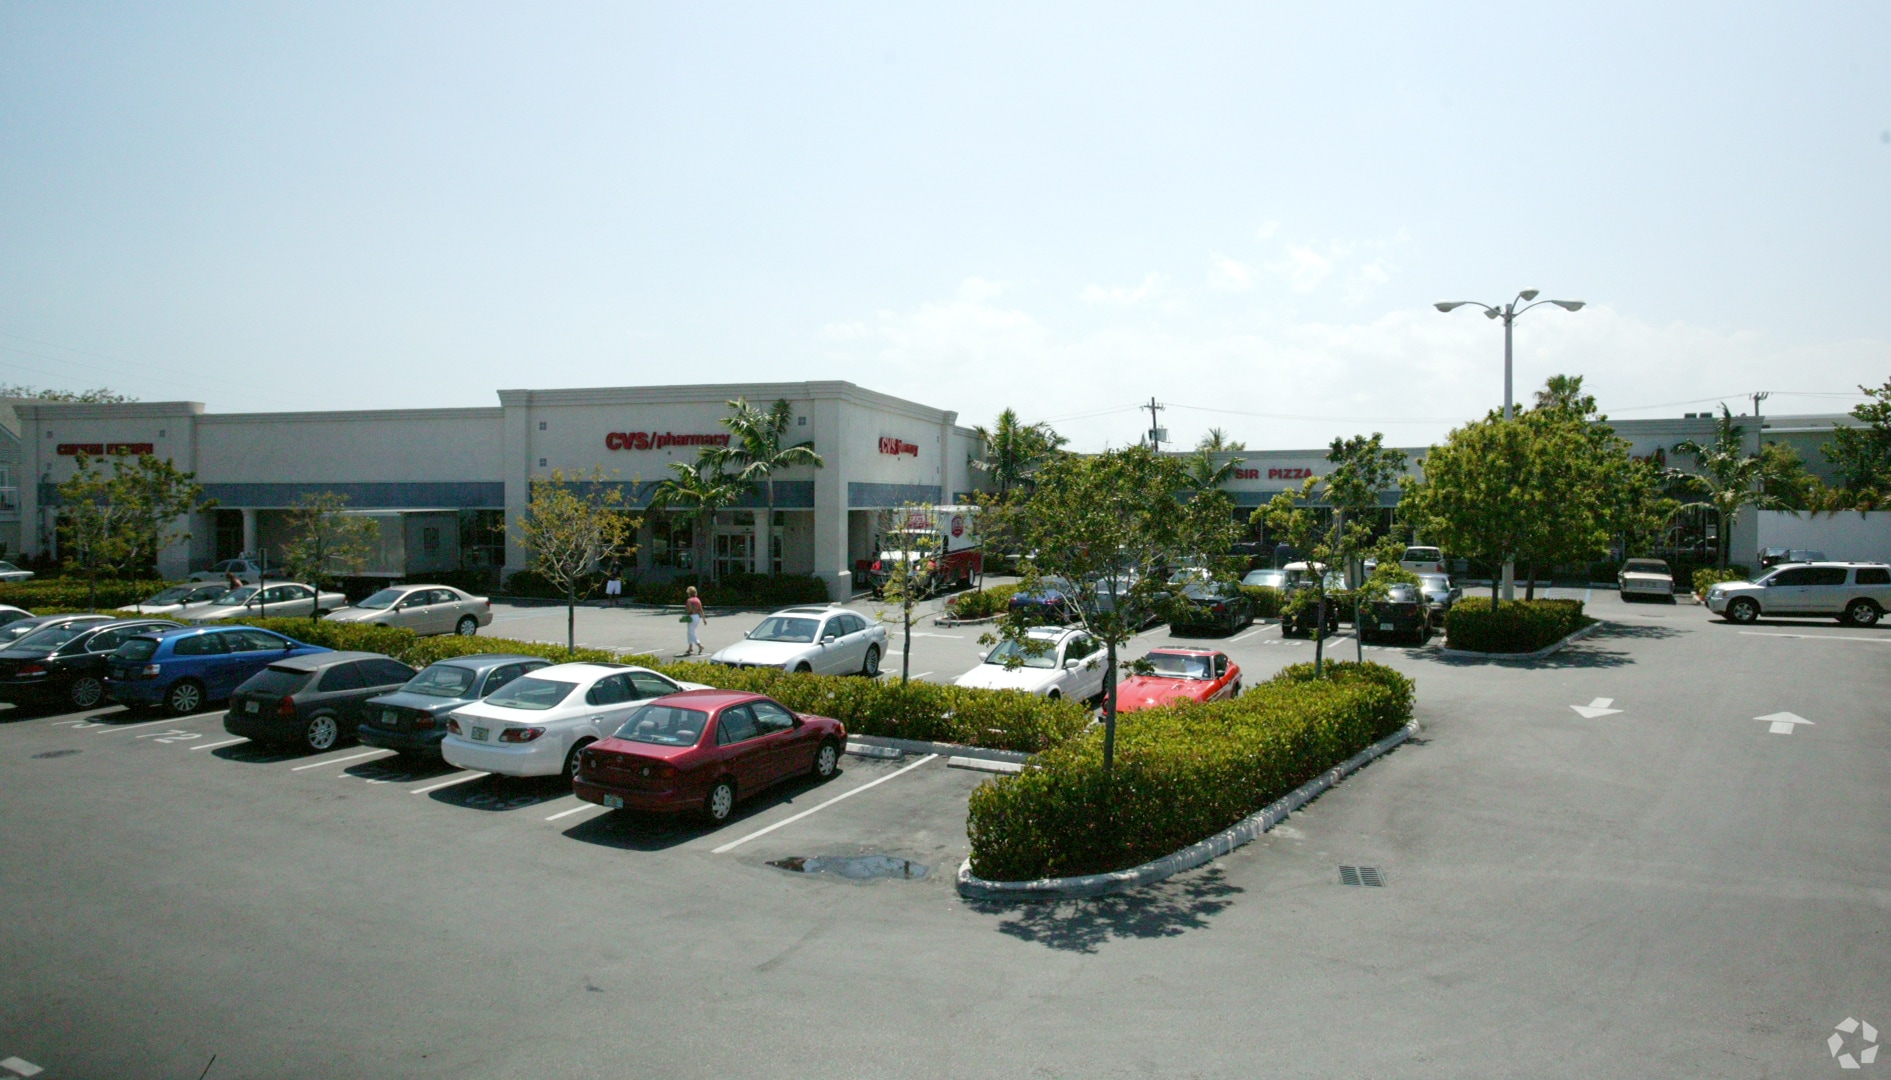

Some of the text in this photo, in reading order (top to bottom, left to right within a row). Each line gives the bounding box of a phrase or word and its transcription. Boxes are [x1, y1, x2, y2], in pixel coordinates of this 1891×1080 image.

[605, 431, 731, 451] CVS/pharmacy
[1235, 468, 1312, 480] SIR PIZZA
